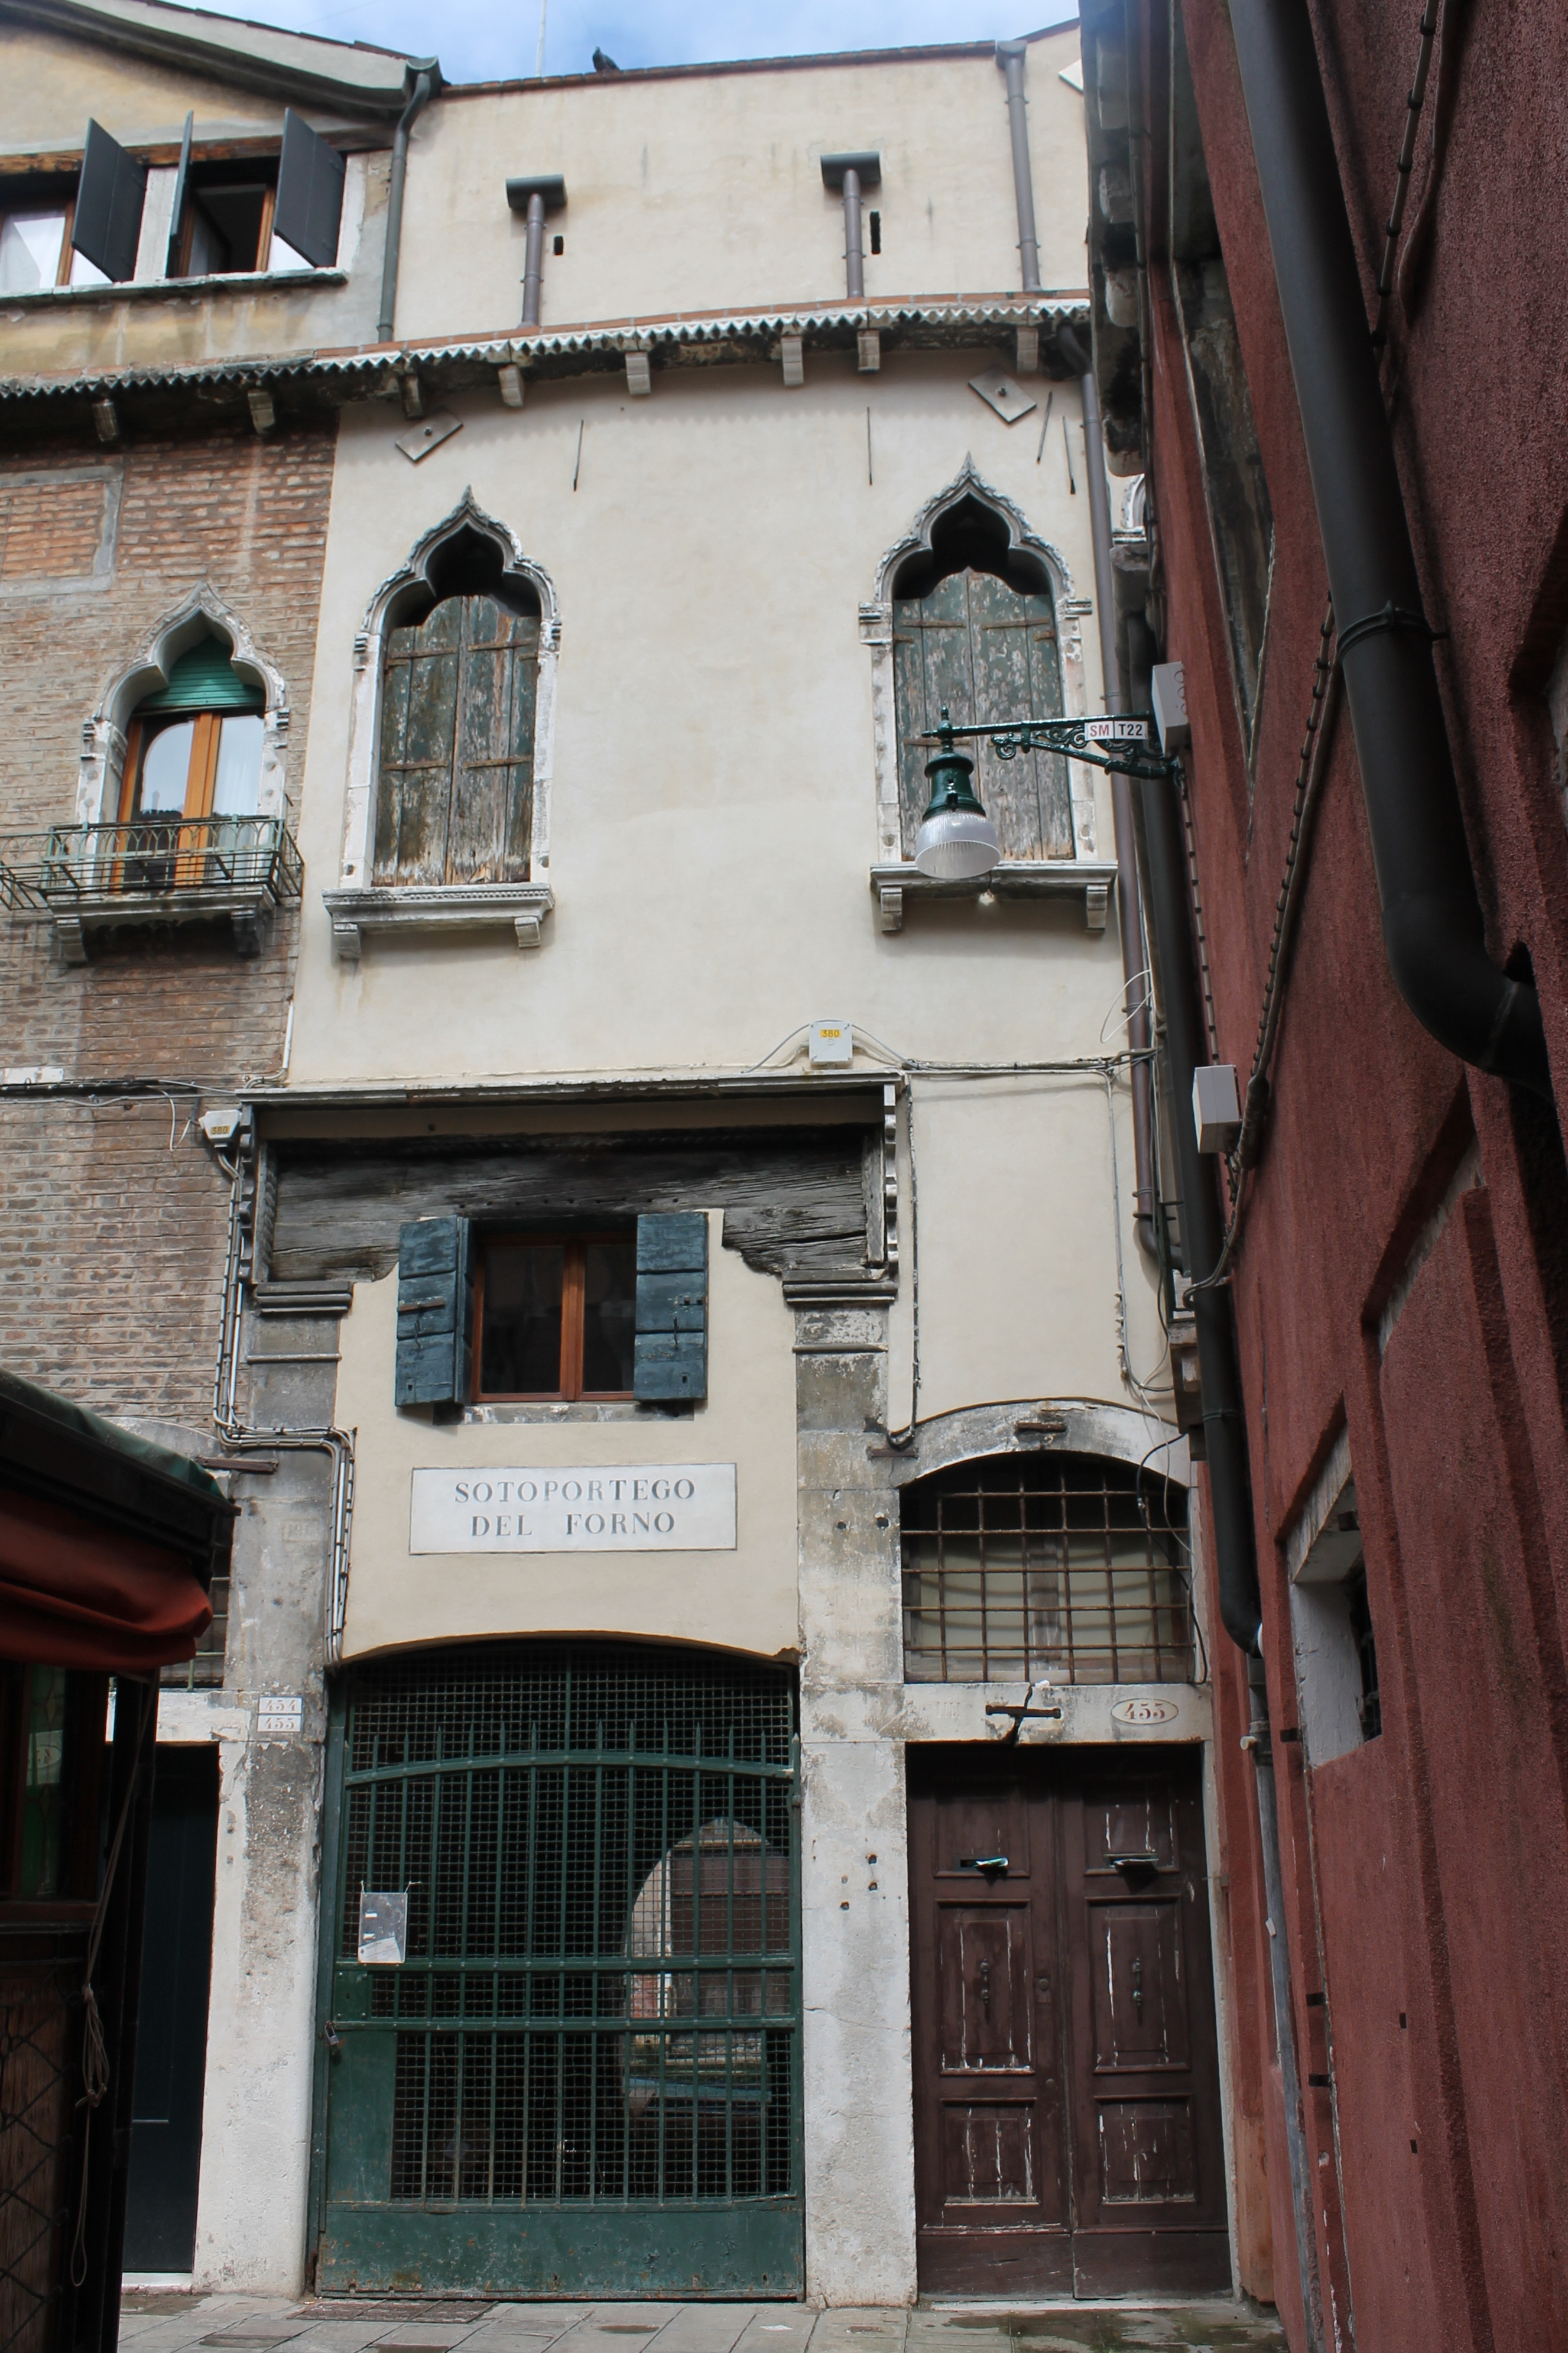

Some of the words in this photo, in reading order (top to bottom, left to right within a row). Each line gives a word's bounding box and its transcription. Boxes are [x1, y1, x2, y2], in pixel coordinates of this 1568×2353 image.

[1089, 724, 1109, 737] SM
[1118, 724, 1142, 736] T22
[822, 1029, 840, 1038] 380
[211, 1126, 228, 1135] 380
[454, 1479, 695, 1504] SOTOPORTEGO
[470, 1514, 533, 1537] DEL
[565, 1511, 675, 1535] FORNO
[265, 1699, 296, 1712] 454
[1123, 1703, 1166, 1720] 453
[265, 1717, 294, 1729] 455
